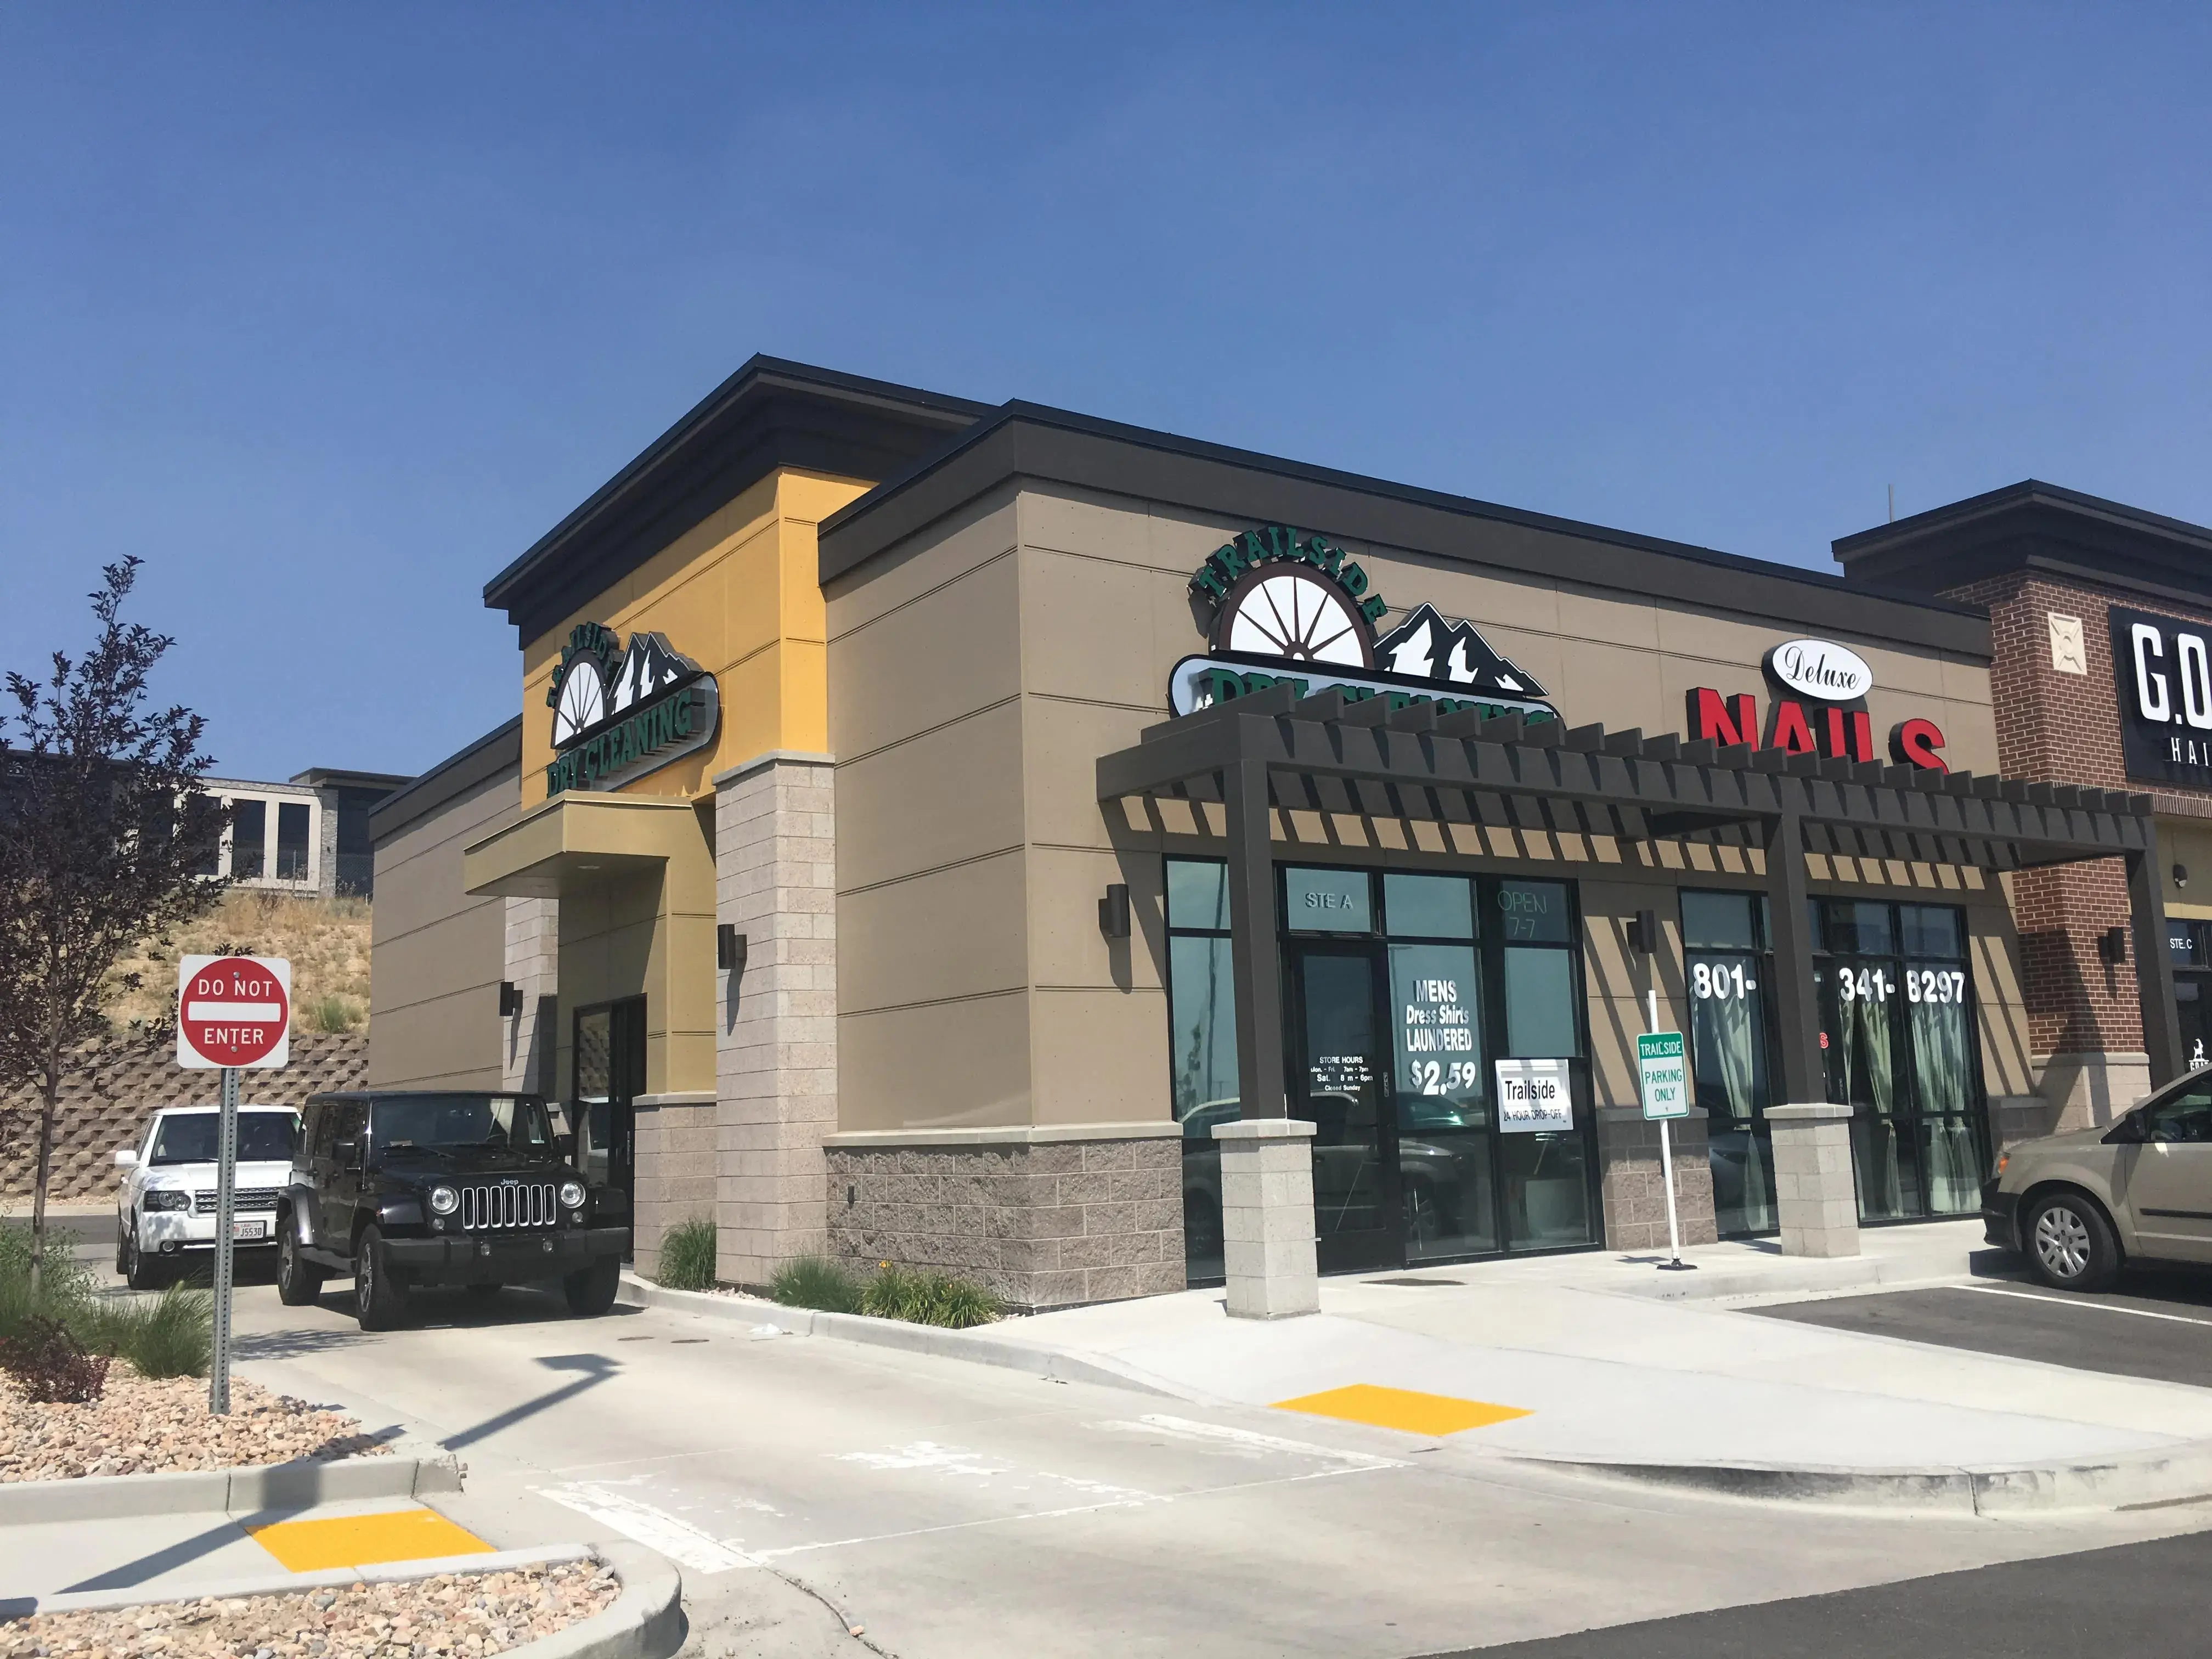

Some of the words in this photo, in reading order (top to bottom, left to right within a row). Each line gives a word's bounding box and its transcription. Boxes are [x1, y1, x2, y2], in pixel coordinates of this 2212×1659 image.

[1198, 527, 1388, 625] TRAILSIDE
[1785, 646, 1861, 690] Deluxe
[585, 689, 692, 780] CLEANING
[1306, 893, 1336, 908] STE
[1341, 895, 1353, 909] A
[1498, 890, 1547, 914] OPEN
[1509, 917, 1535, 938] 7-7
[2187, 939, 2192, 950] C
[199, 979, 224, 996] DO
[235, 980, 273, 997] NOT
[1415, 980, 1457, 1002] MENS
[1693, 963, 1757, 1000] 801-
[1406, 1005, 1436, 1024] Dress
[1439, 1005, 1469, 1024] Shirts
[204, 1028, 263, 1045] ENTER
[1407, 1029, 1472, 1052] LAUNDERED
[1640, 1041, 1682, 1057] TRAILSIDE
[1317, 1074, 1331, 1082] Sat.
[1412, 1059, 1476, 1096] $2.59
[1645, 1069, 1682, 1085] PARKING
[1505, 1080, 1555, 1100] Trailside
[1655, 1087, 1675, 1102] ONLY
[1504, 1110, 1511, 1121] 24
[1513, 1110, 1531, 1121] HOUR
[1531, 1109, 1562, 1120] DROP-OFF
